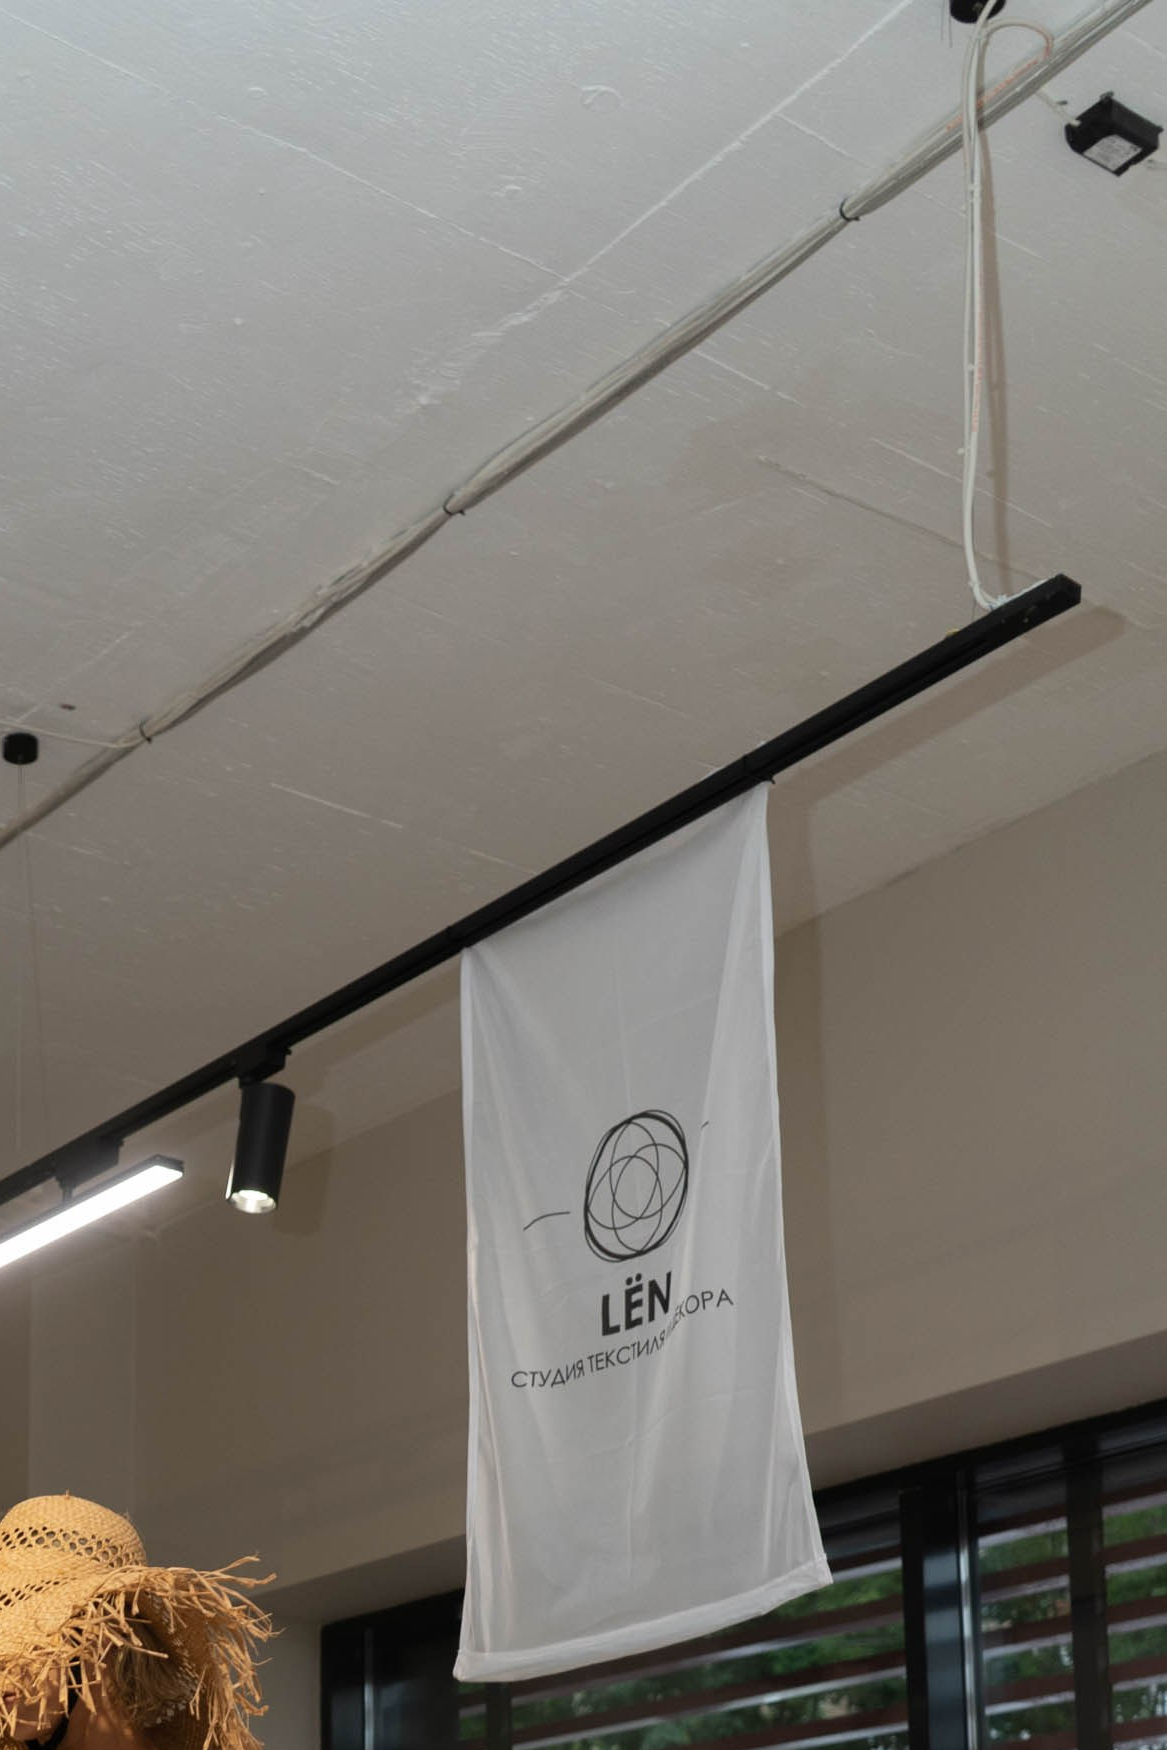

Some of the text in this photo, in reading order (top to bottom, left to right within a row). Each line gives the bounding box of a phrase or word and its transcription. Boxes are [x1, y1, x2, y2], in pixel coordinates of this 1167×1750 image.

[510, 1358, 585, 1388] СТУДИЯ
[587, 1329, 666, 1373] ТЕКСТИЛЯ
[671, 1288, 734, 1332] ЕКОРА
[601, 1271, 672, 1337] LËN
